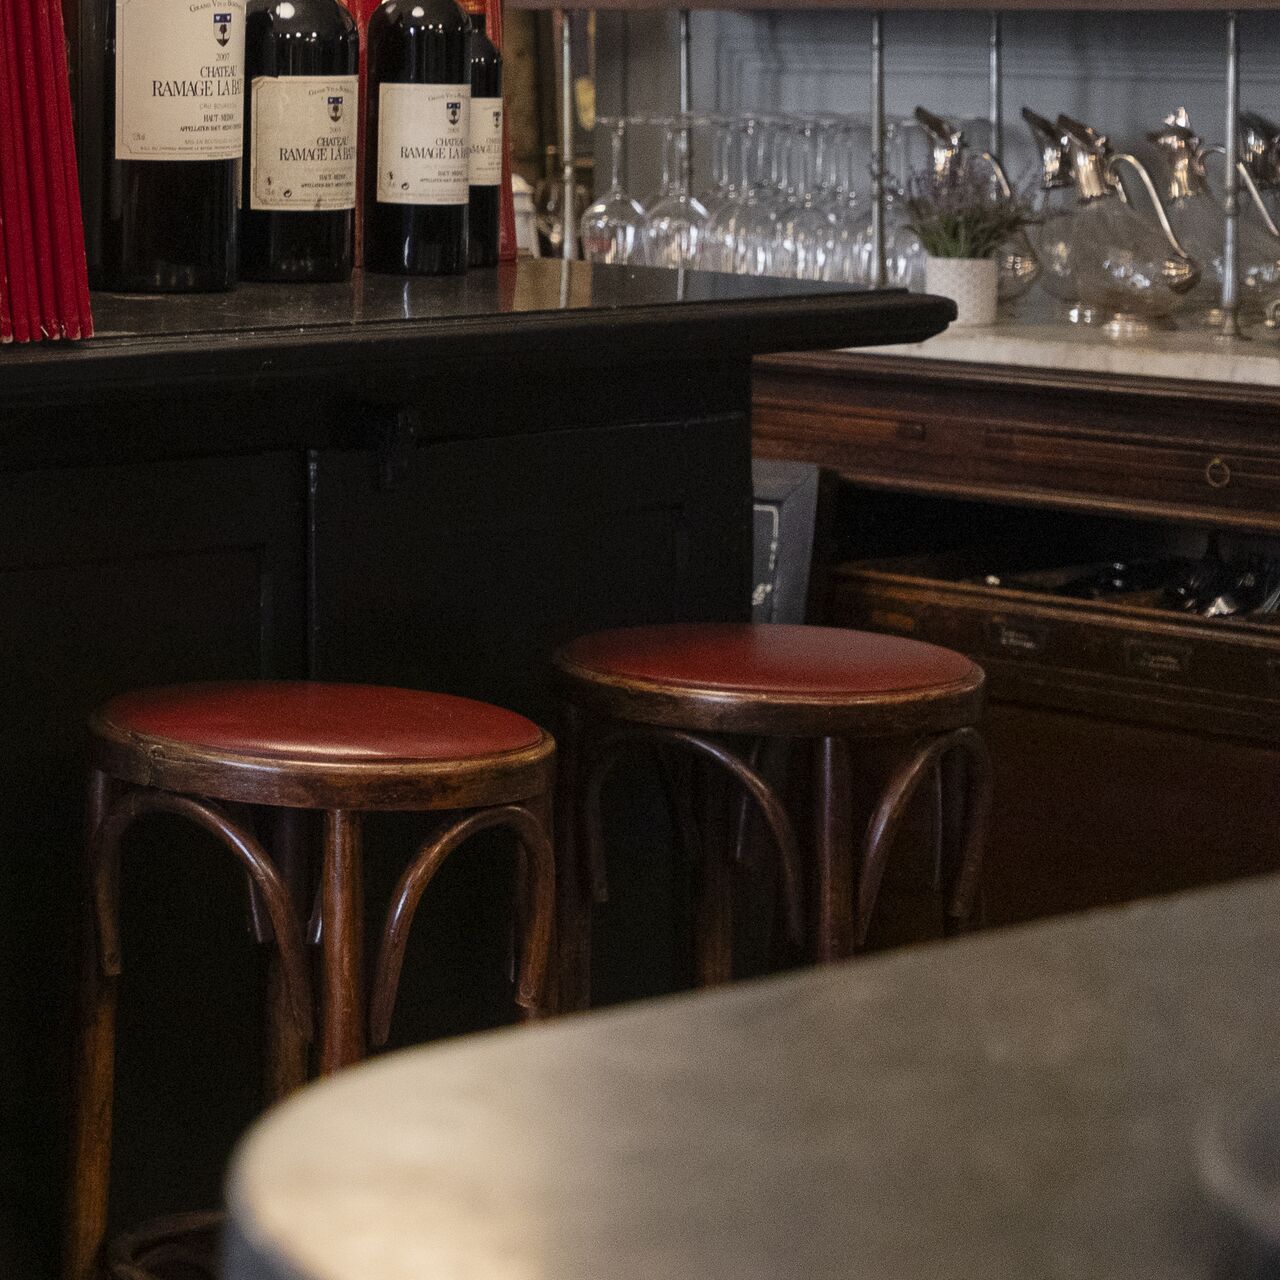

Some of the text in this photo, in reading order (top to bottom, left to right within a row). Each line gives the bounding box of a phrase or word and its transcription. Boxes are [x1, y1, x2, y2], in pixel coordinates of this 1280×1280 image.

[152, 80, 213, 97] RAMAGE
[217, 80, 230, 96] LA
[279, 148, 327, 161] RAMAGE
[400, 146, 446, 159] RAMAGE
